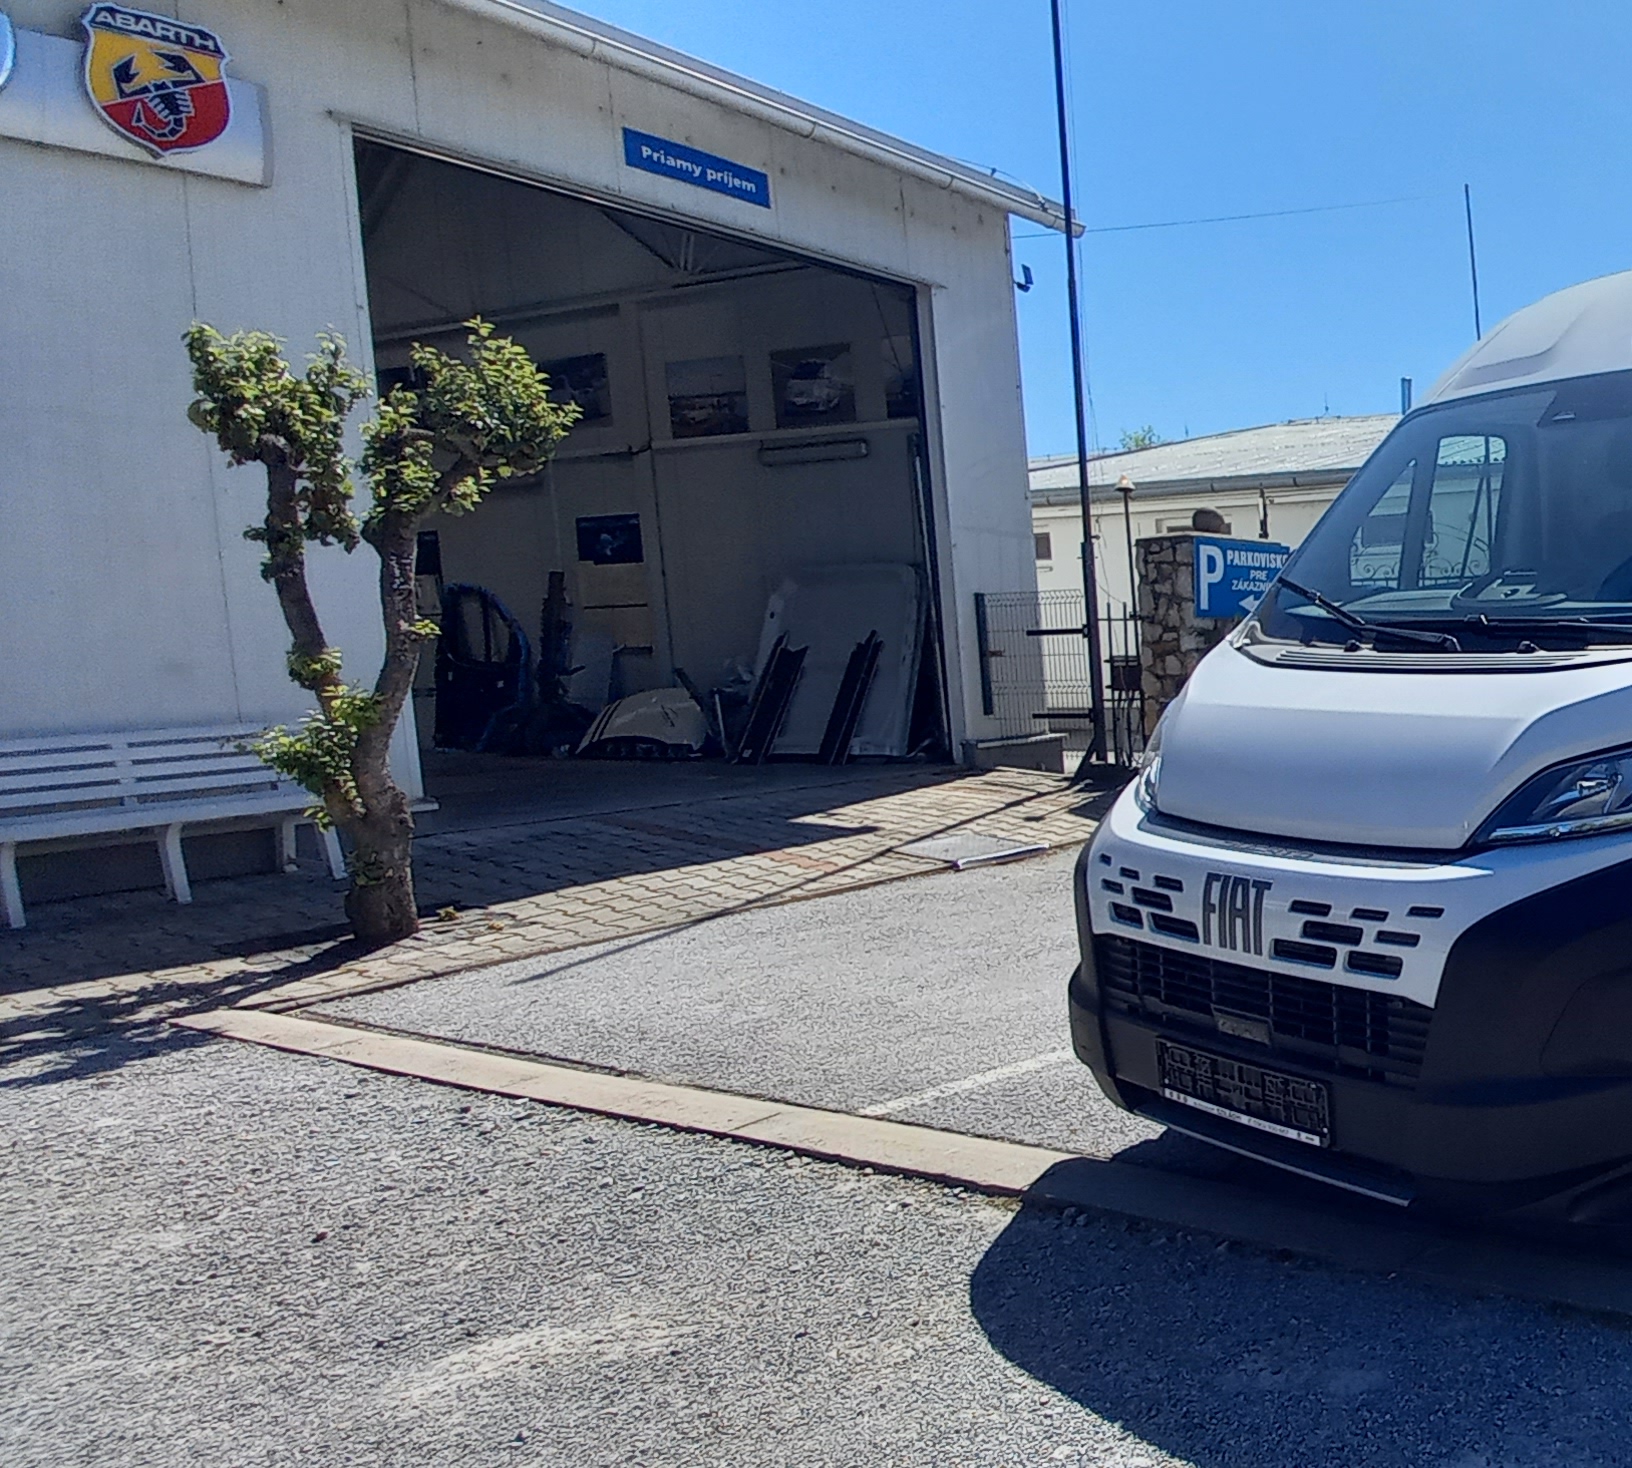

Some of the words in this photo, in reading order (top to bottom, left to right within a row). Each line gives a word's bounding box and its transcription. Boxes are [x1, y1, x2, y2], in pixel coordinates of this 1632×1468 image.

[95, 10, 215, 50] ABARTH
[641, 145, 703, 177] Priamy
[1199, 544, 1225, 610] P
[1249, 569, 1268, 581] PRE
[1202, 872, 1274, 957] FIAT
